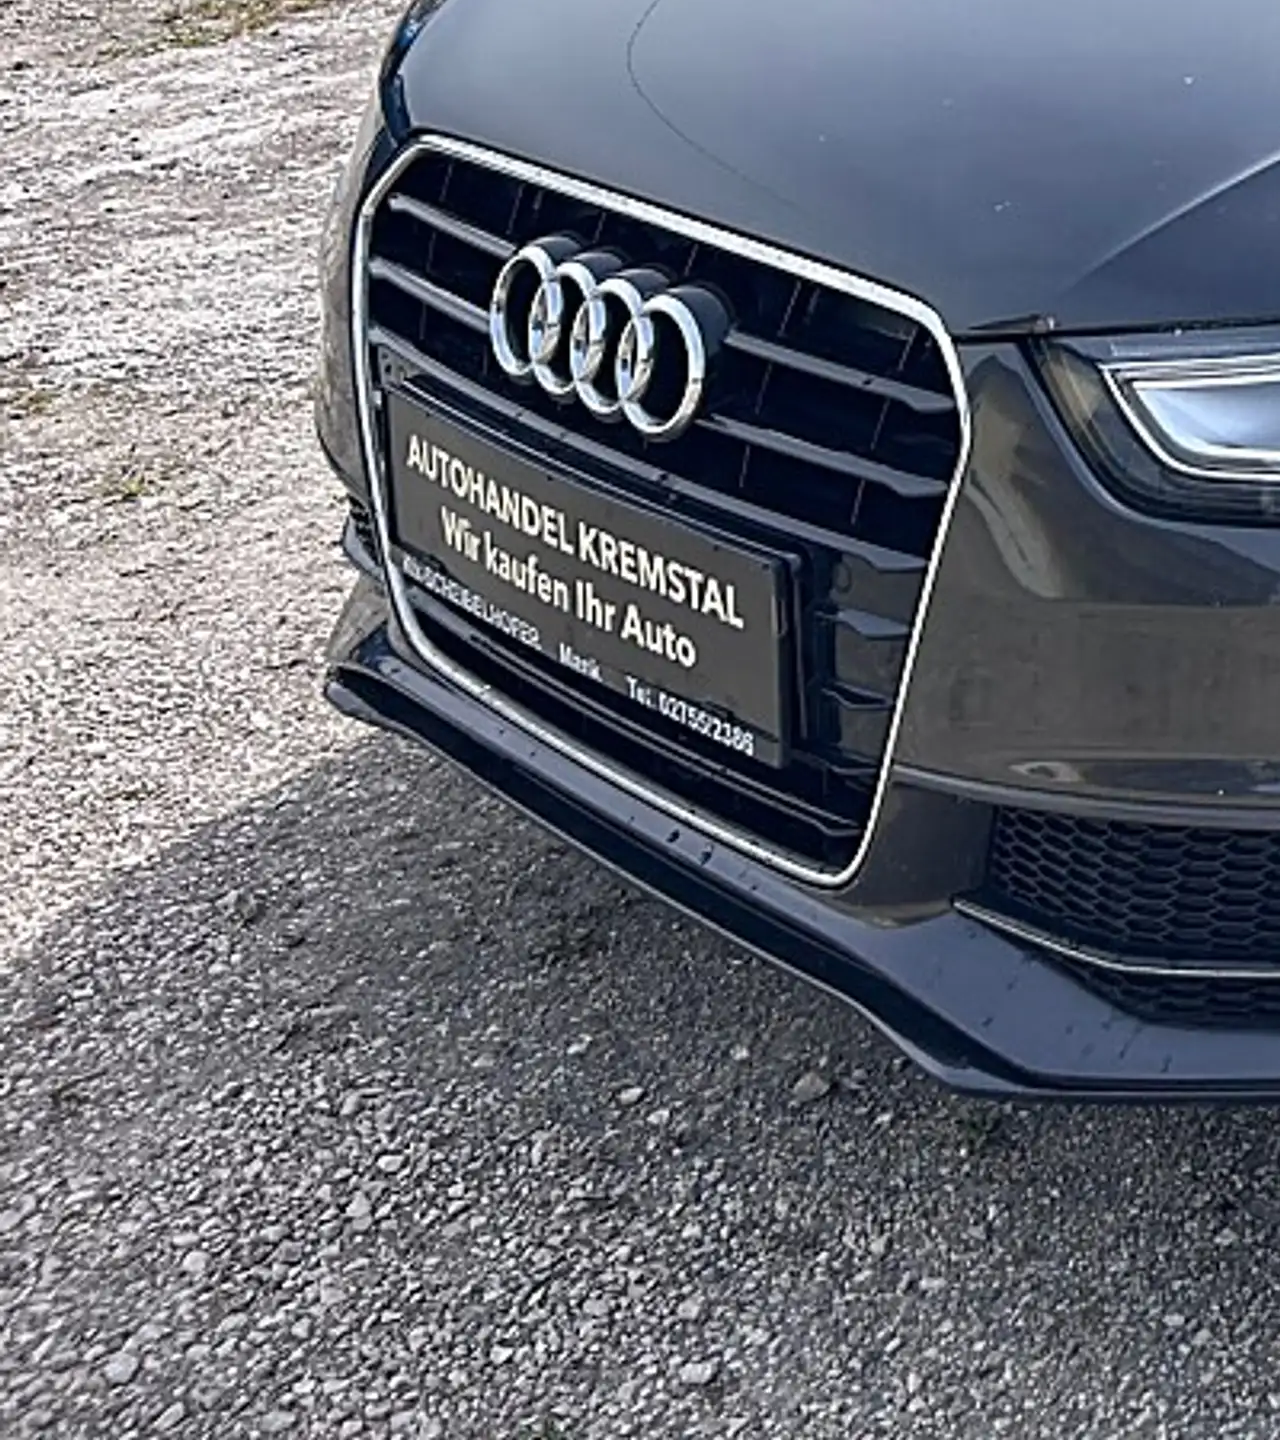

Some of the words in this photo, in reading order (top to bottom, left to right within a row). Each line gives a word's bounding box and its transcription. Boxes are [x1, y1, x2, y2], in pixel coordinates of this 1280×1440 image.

[407, 434, 573, 556] AUTOHANDEL
[578, 521, 744, 629] KREMSTAL
[440, 505, 479, 562] Wir
[484, 530, 569, 612] kaufen
[576, 580, 616, 633] Ihr
[620, 605, 697, 668] Auto
